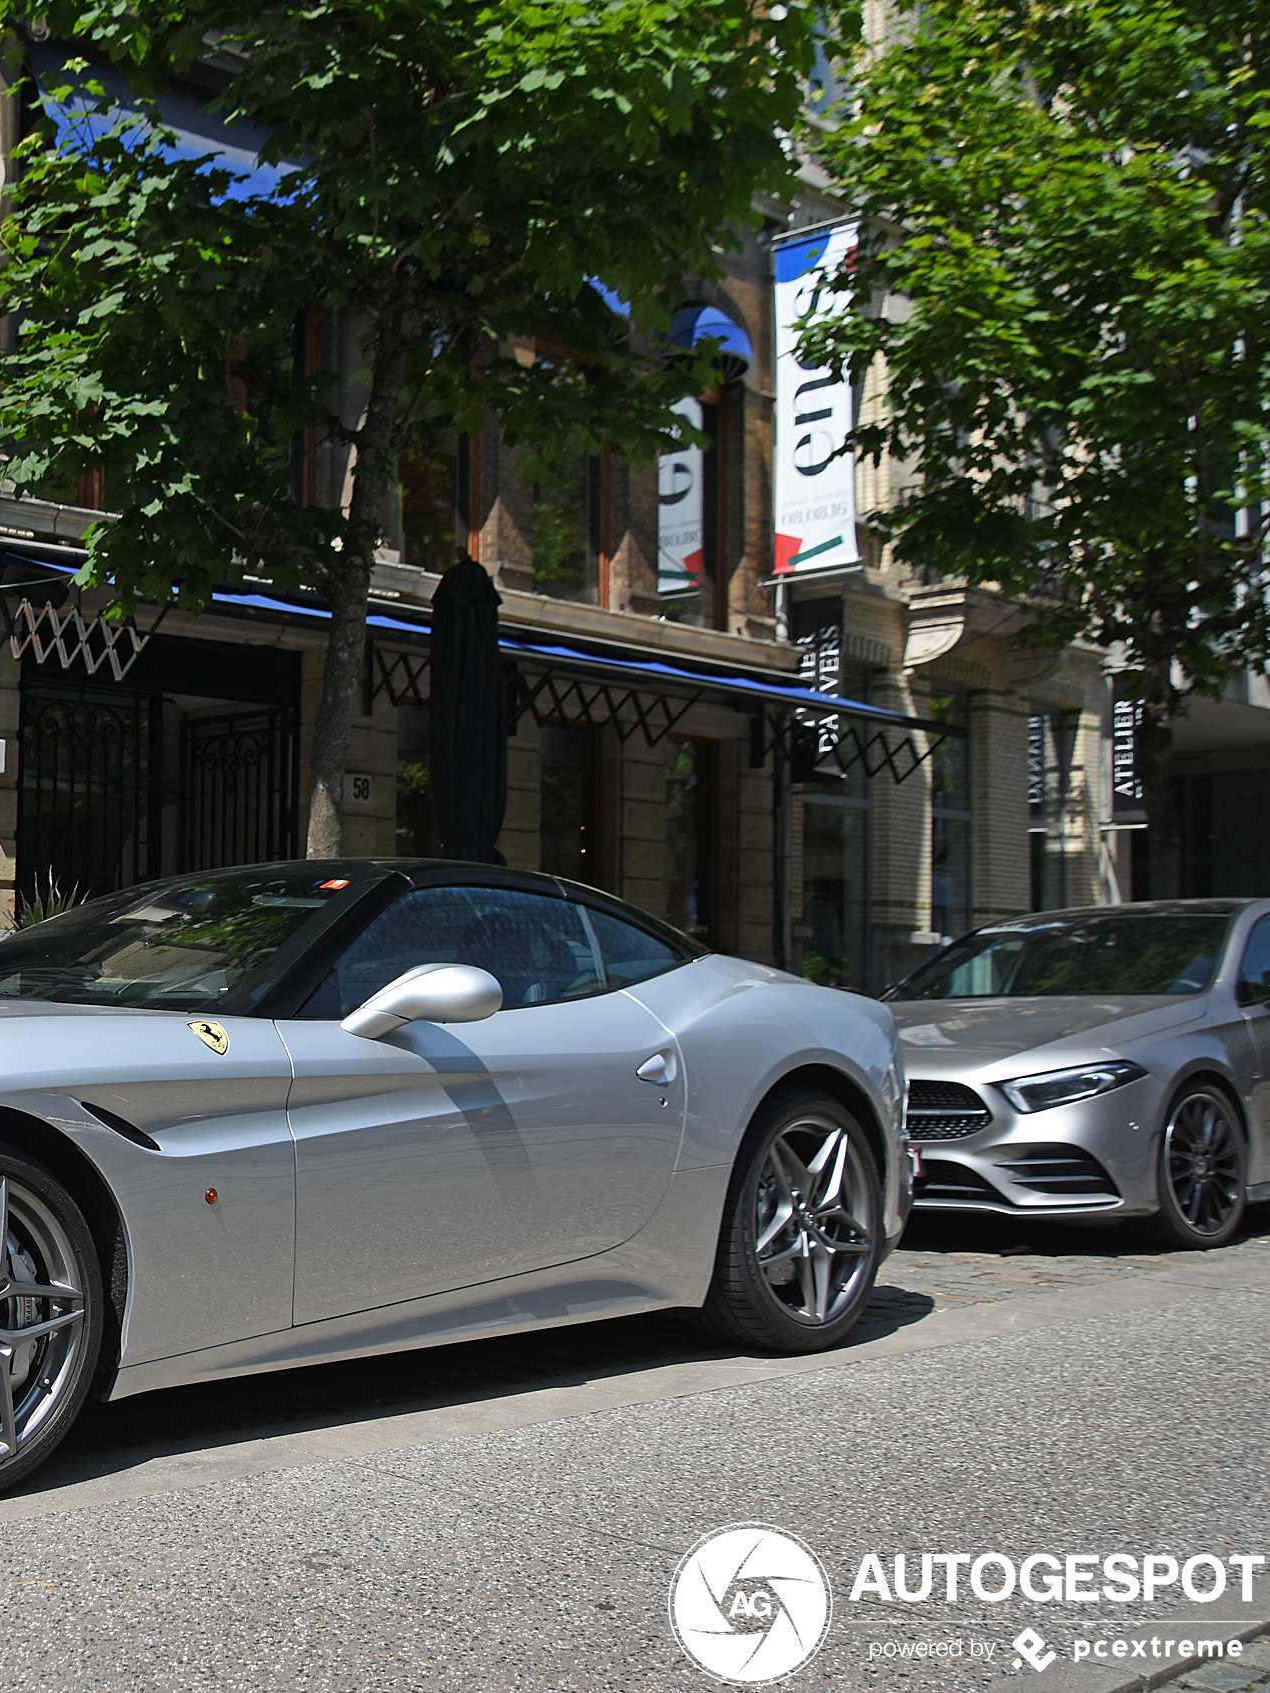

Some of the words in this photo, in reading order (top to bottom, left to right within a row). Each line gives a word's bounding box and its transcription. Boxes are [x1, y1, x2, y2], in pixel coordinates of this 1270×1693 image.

[818, 625, 840, 753] D'AVERS
[353, 777, 370, 800] 58
[1113, 700, 1134, 796] ATELIER
